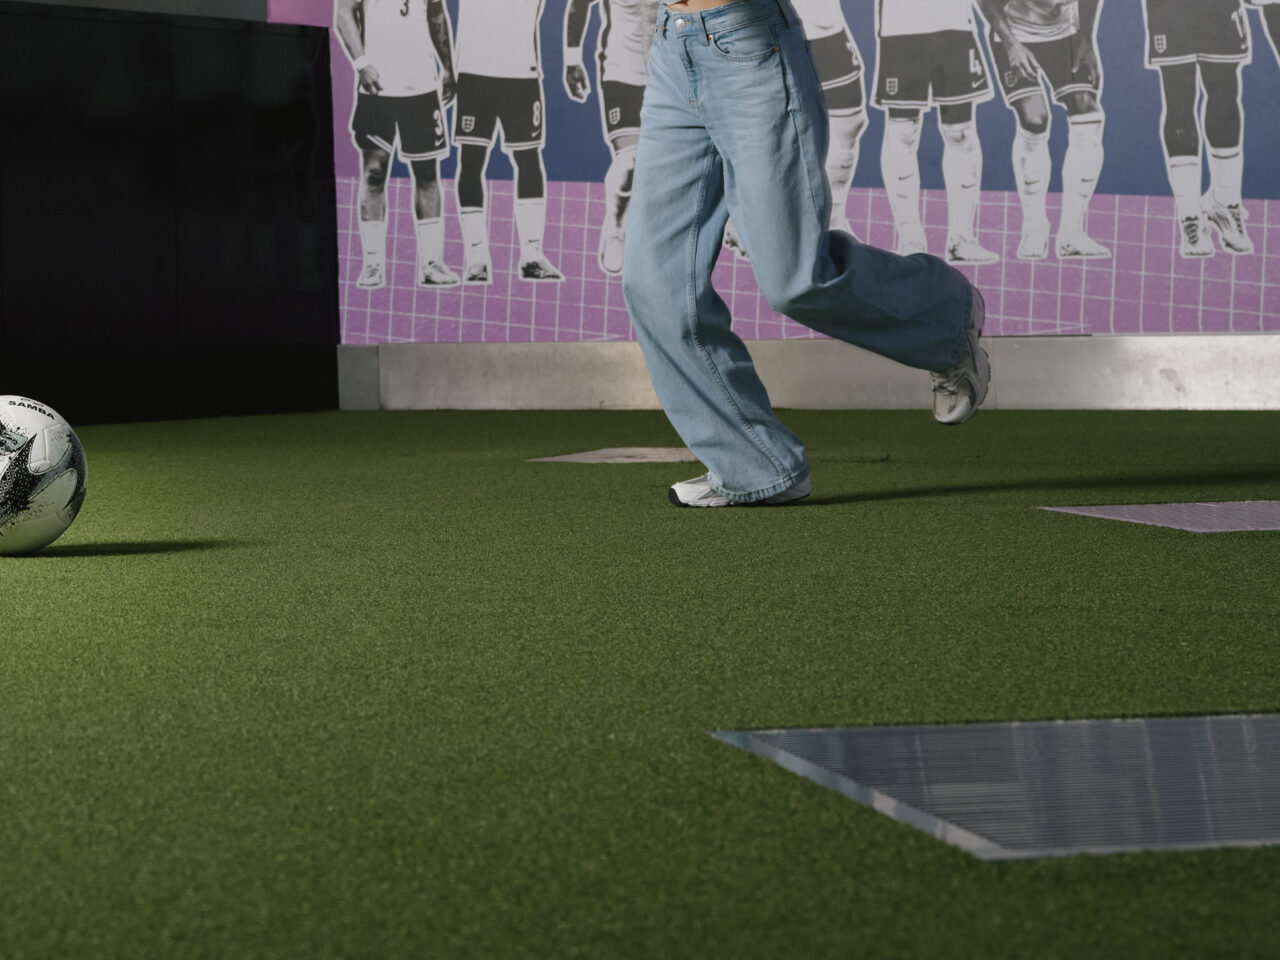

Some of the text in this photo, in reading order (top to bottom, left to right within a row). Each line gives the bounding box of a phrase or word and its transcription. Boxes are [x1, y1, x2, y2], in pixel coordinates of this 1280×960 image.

[969, 48, 982, 75] 4
[433, 109, 443, 135] 3
[533, 101, 541, 127] 8
[8, 400, 55, 420] SAMBA
